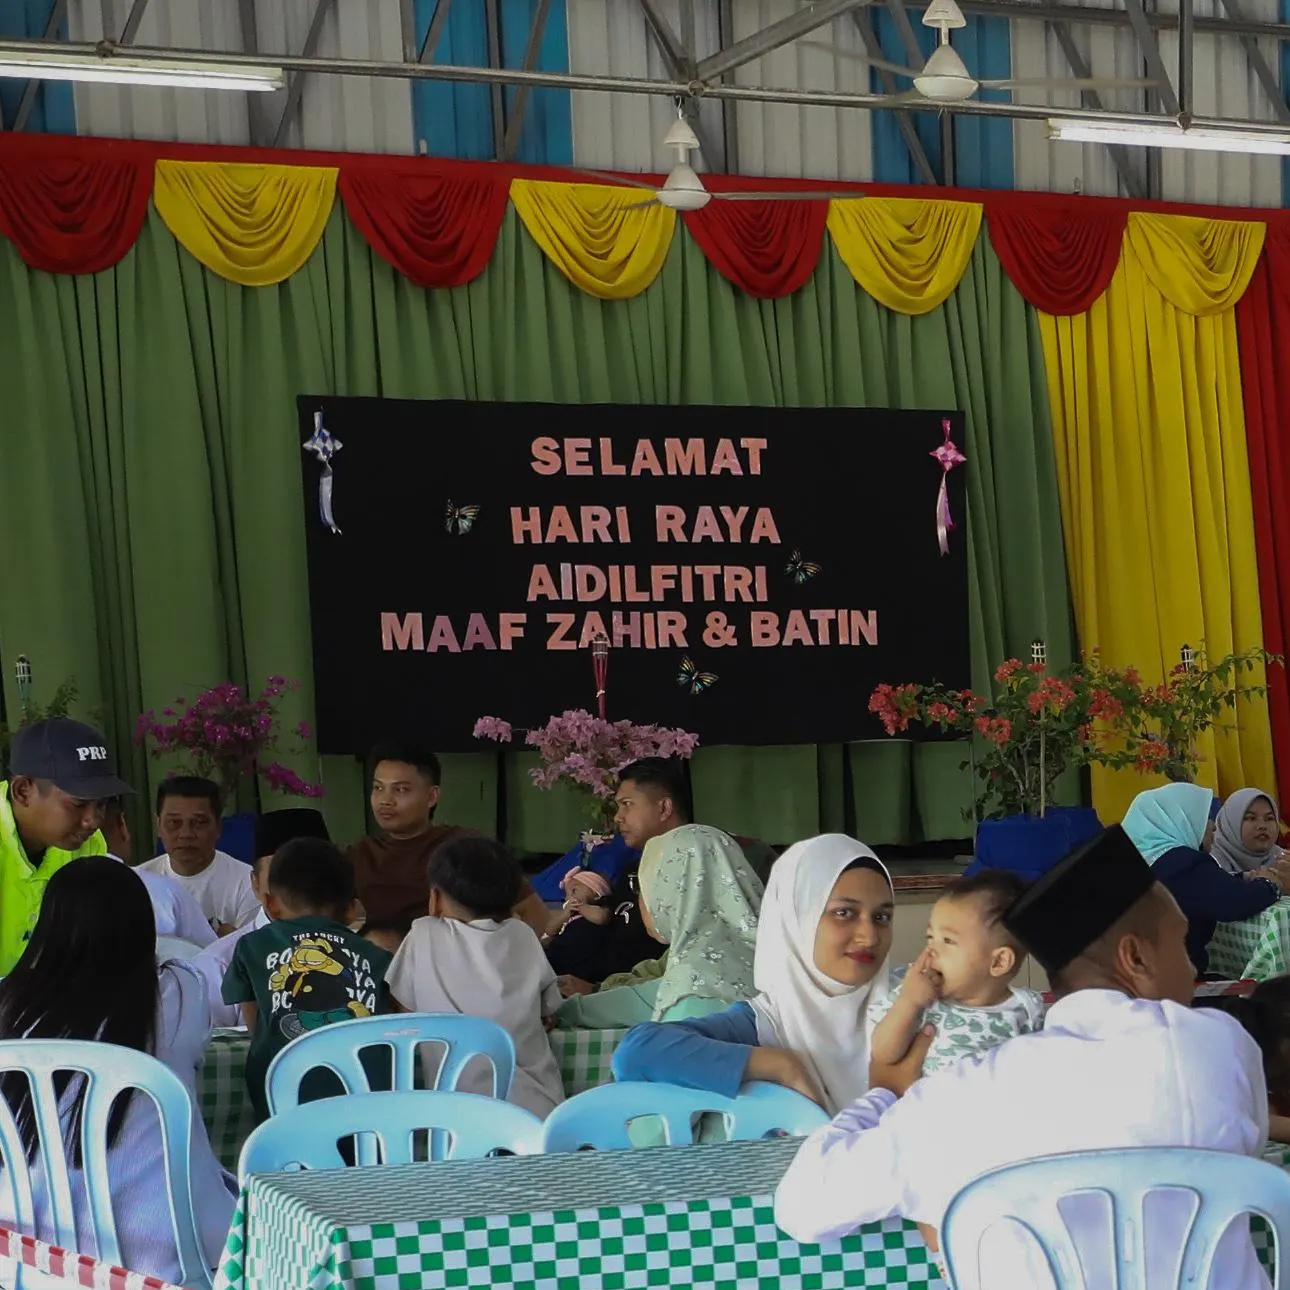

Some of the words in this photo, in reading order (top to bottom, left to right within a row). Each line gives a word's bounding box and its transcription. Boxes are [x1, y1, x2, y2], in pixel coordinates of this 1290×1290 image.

[530, 437, 768, 476] SELAMAT
[510, 505, 631, 544] HARI
[655, 505, 781, 544] RAYA
[527, 563, 768, 602] AIDILFITRI
[381, 611, 527, 652] MAAF
[546, 610, 689, 650] ZAHIR
[702, 611, 738, 648] &
[750, 608, 878, 647] BATIN
